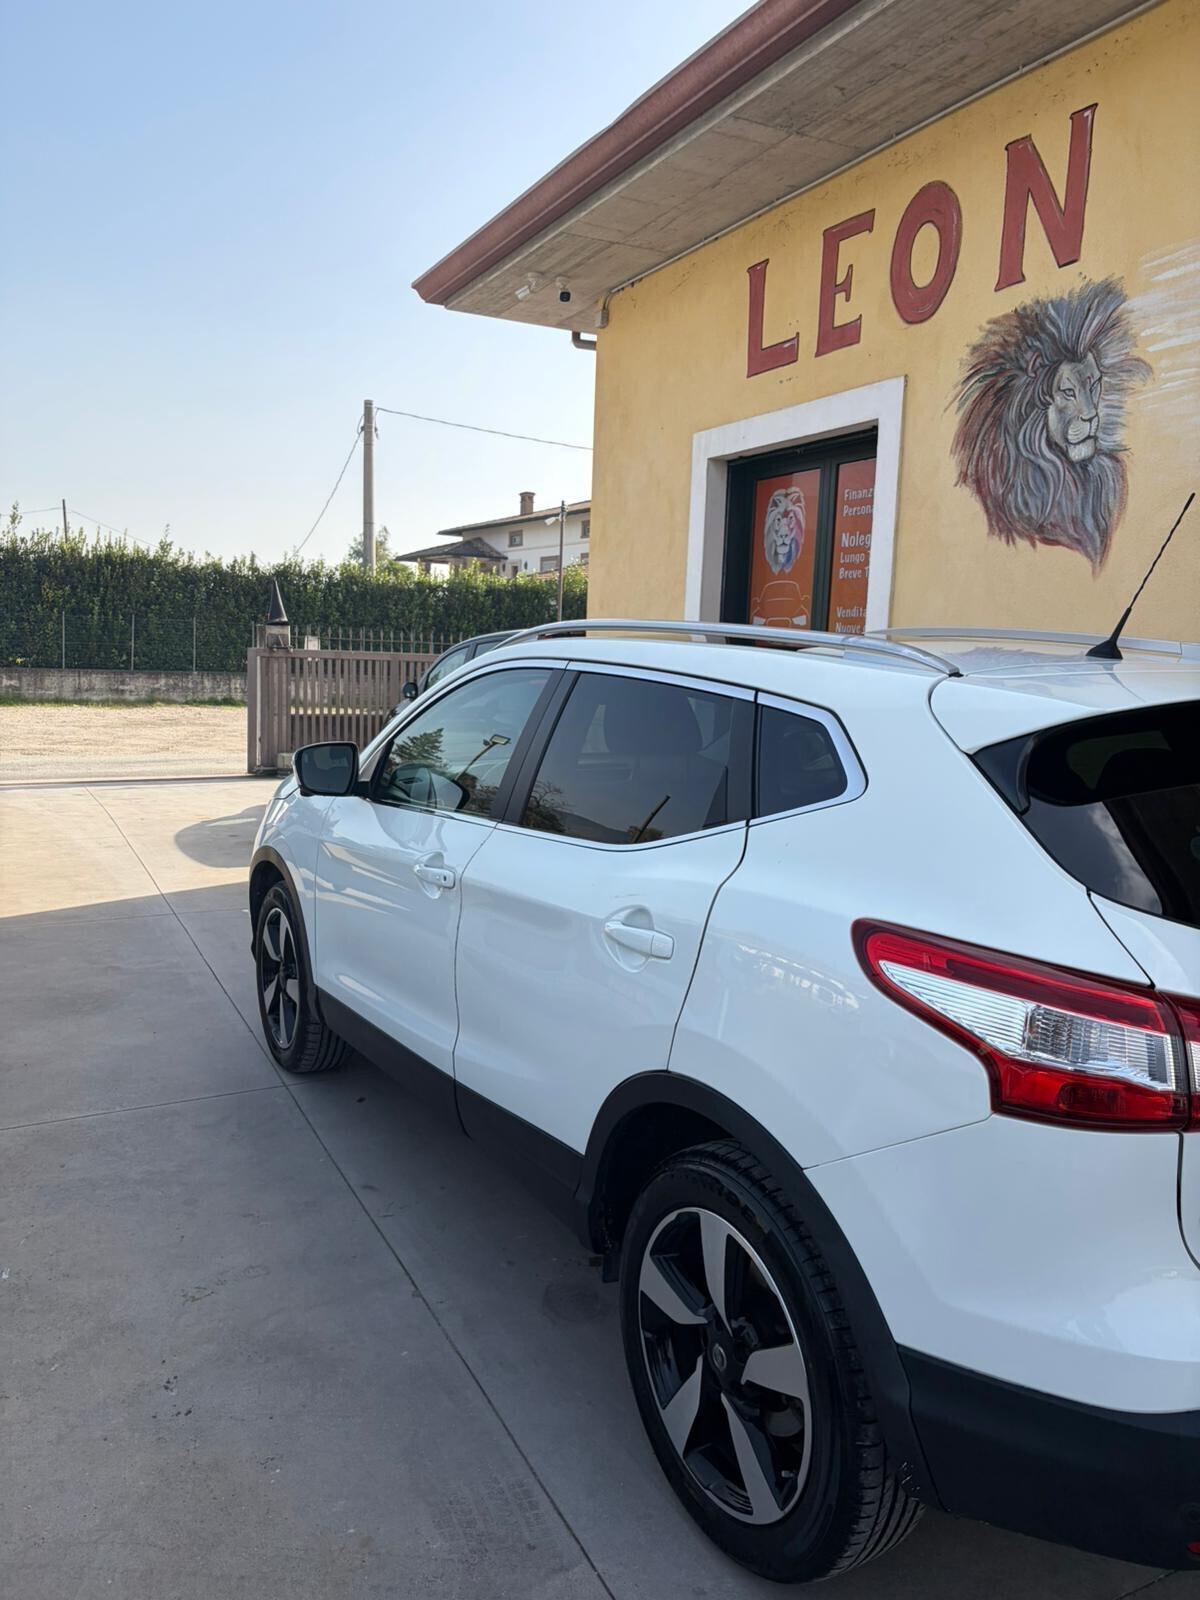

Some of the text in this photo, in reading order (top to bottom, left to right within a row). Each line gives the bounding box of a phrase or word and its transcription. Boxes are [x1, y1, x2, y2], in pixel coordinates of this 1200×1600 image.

[747, 103, 1098, 378] LEON
[840, 551, 865, 564] Lungo
[839, 567, 862, 579] Breve
[835, 622, 861, 634] Nuove
